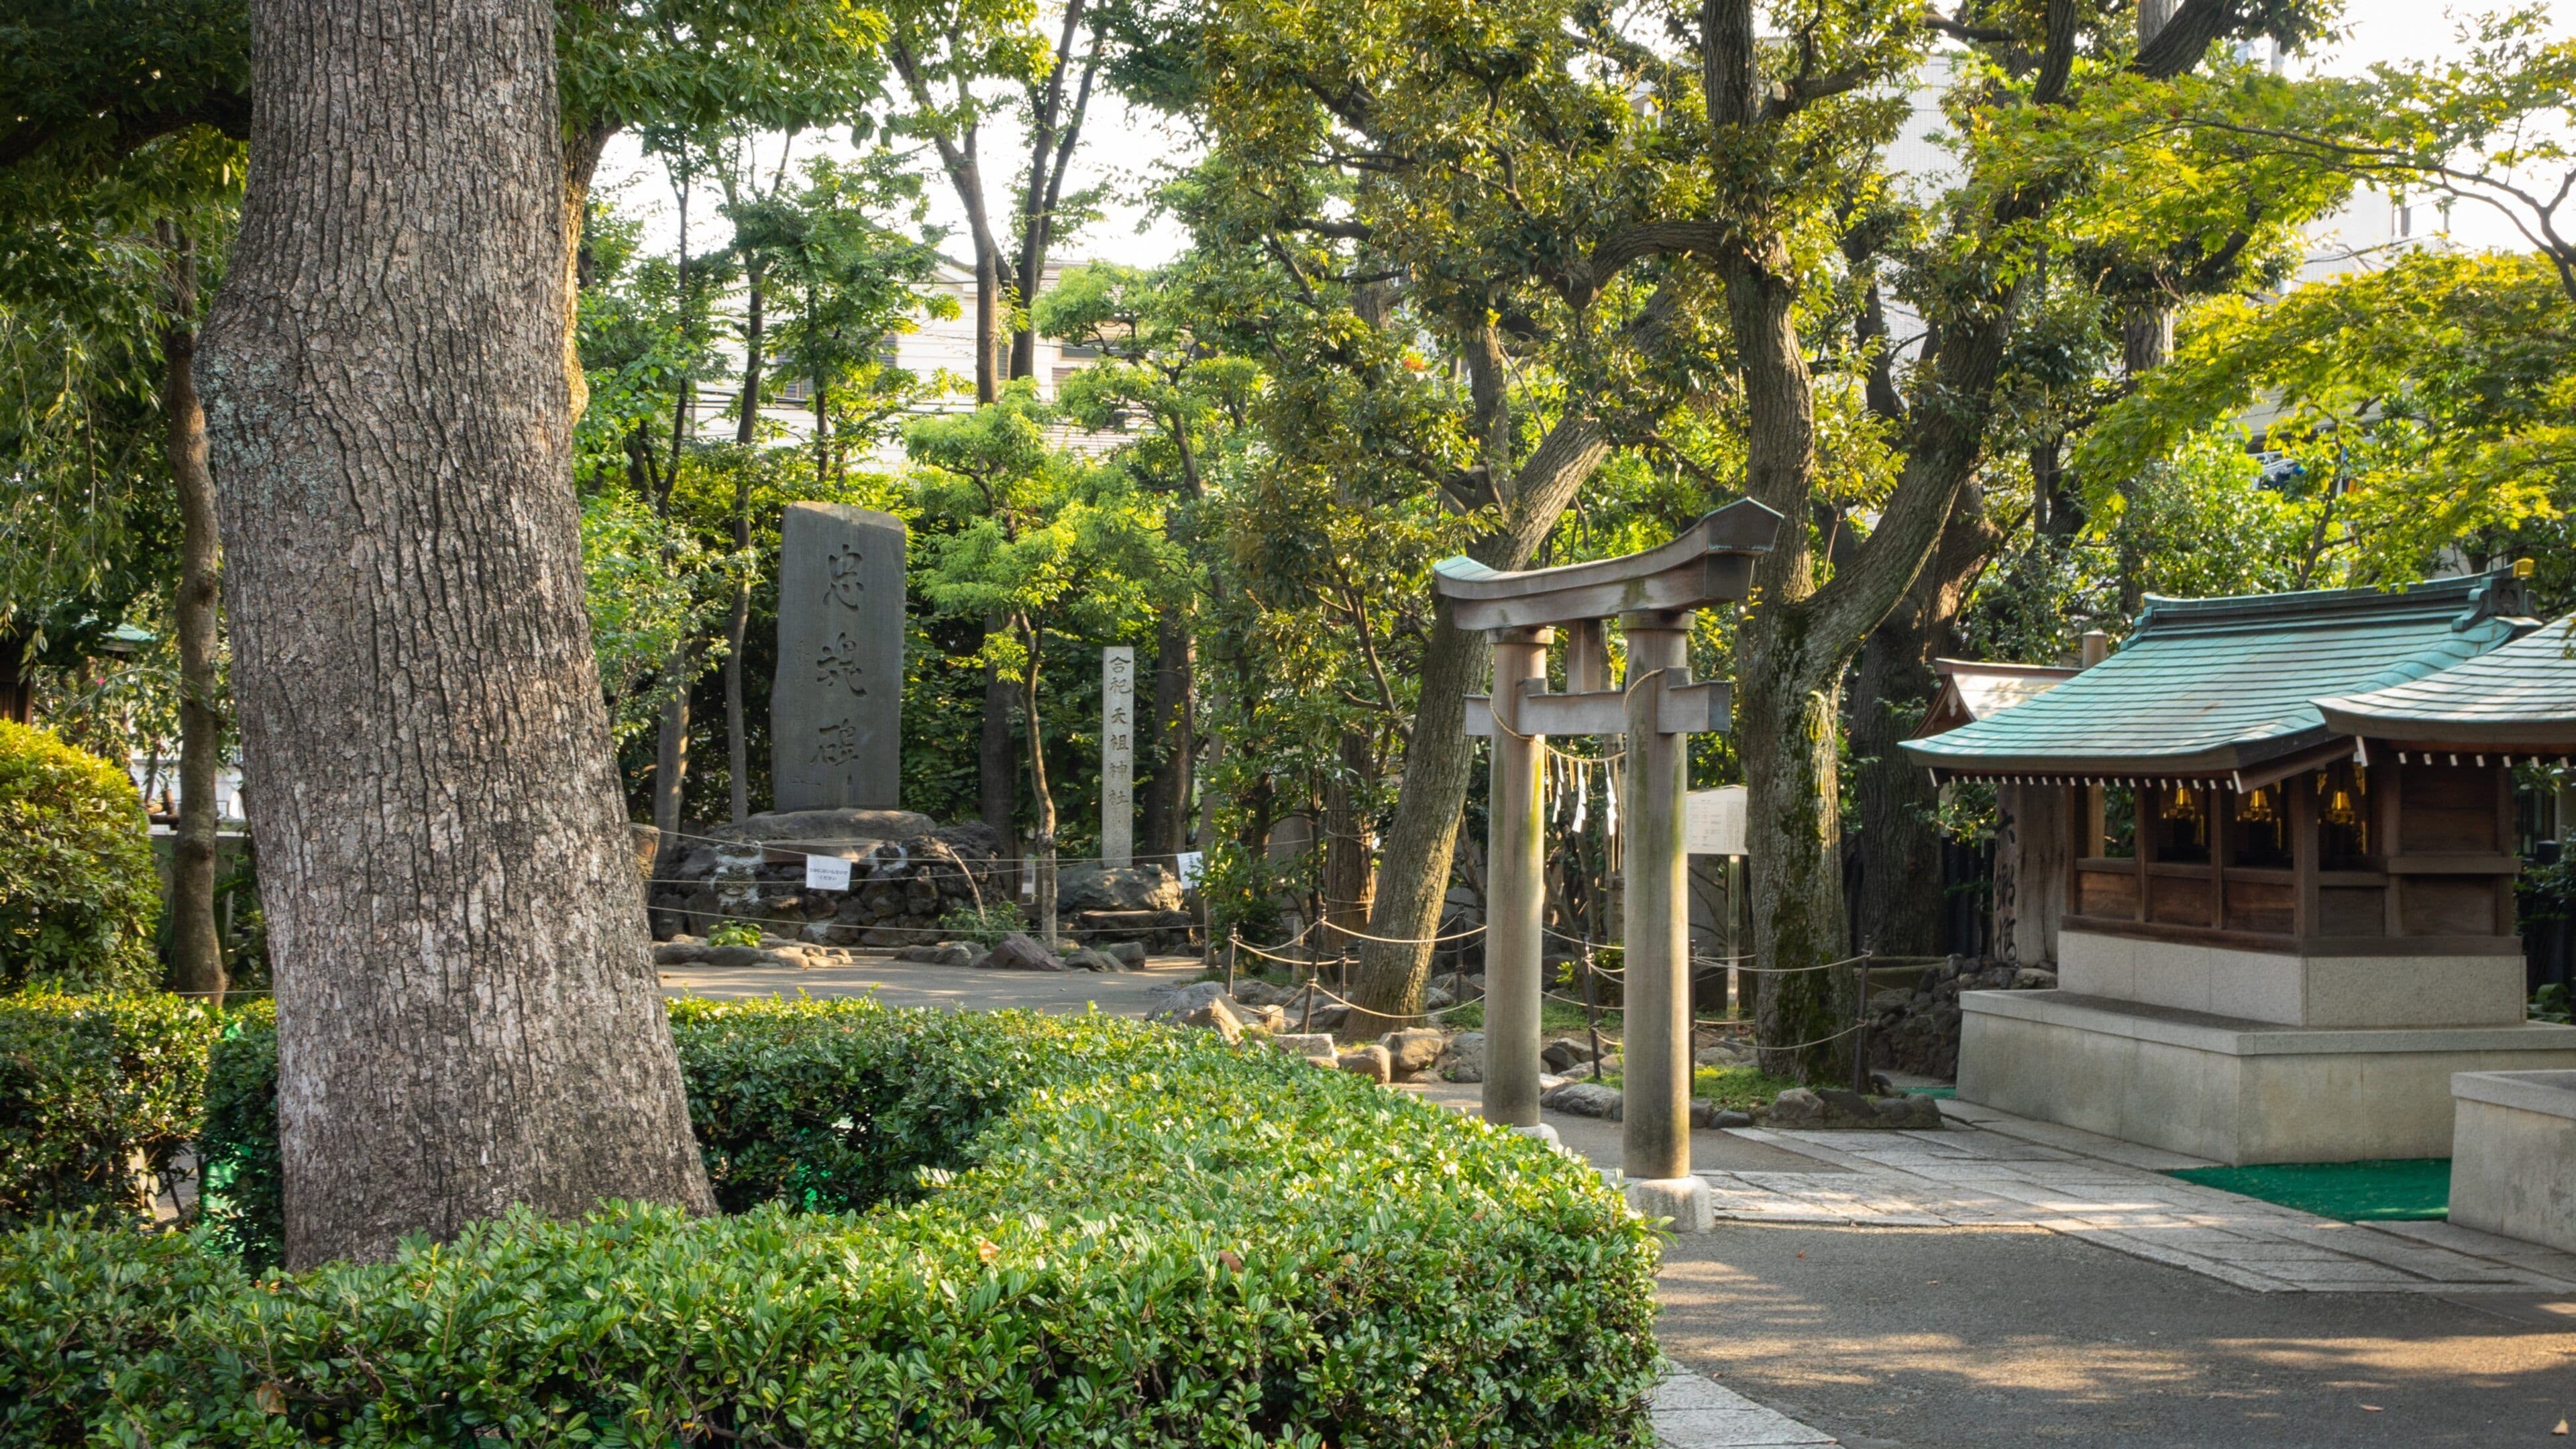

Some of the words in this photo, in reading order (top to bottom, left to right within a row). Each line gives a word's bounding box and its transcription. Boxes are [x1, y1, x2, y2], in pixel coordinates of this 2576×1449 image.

[809, 543, 867, 786] 忠魂碑
[1108, 655, 1132, 806] 合祀天祖神社
